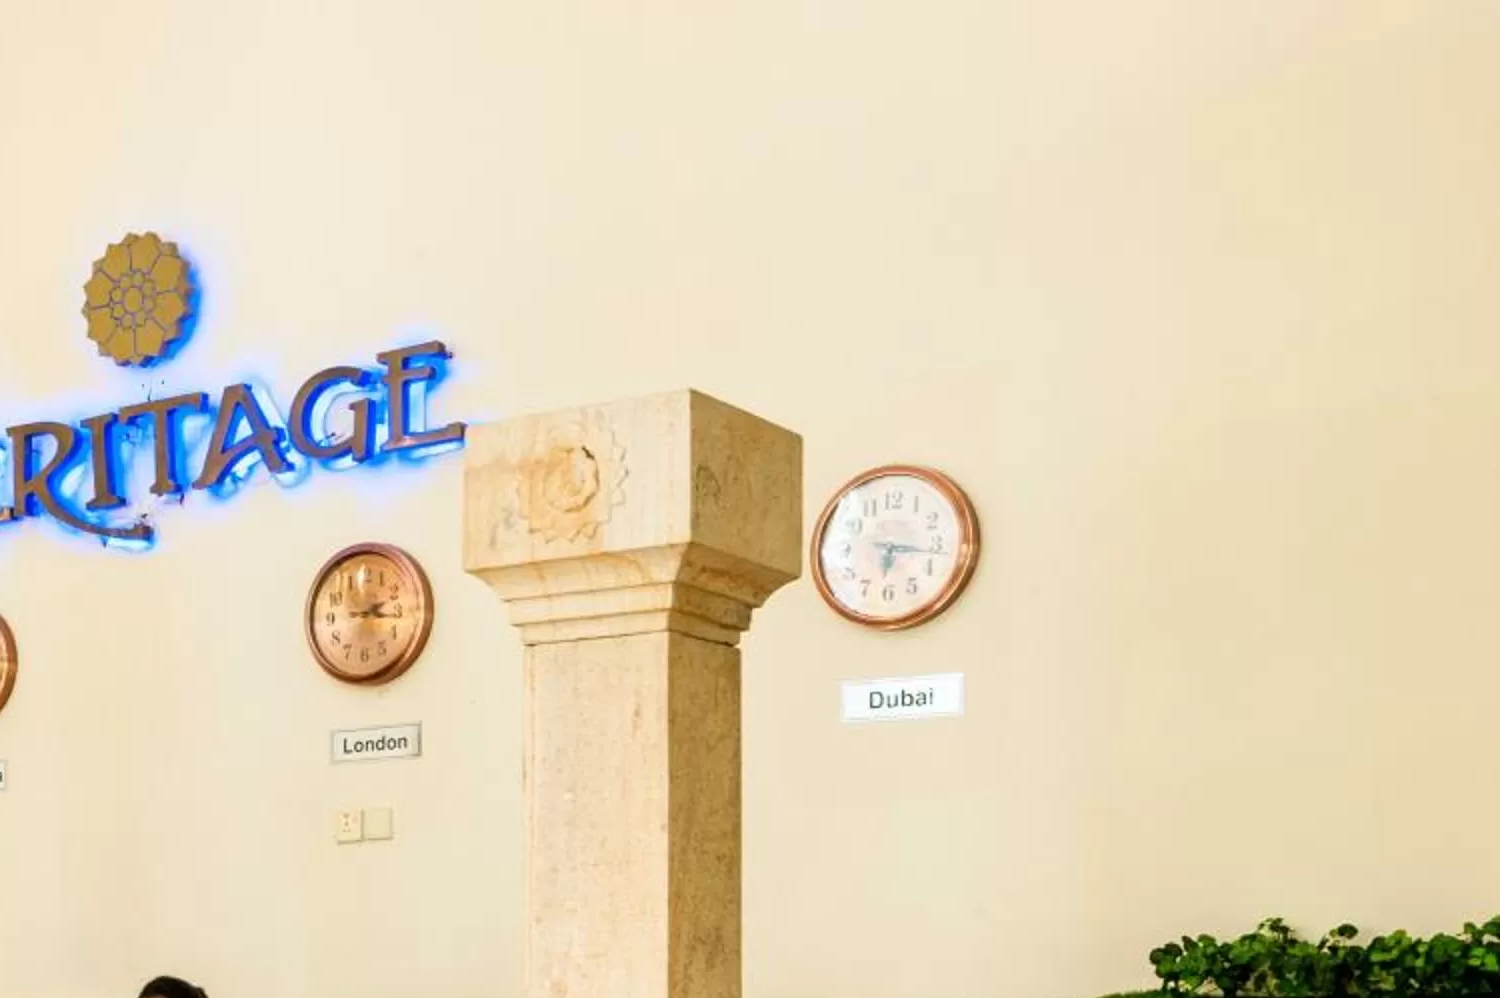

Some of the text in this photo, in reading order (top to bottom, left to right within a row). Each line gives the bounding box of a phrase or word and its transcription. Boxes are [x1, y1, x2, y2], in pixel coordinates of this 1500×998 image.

[863, 499, 877, 517] 11
[884, 491, 904, 510] 12
[913, 495, 919, 513] 1
[925, 511, 939, 530] 2
[931, 534, 943, 554] 3
[379, 570, 385, 587] 1
[905, 577, 918, 595] 5
[389, 583, 399, 600] 2
[859, 579, 872, 597] 7
[882, 583, 896, 601] 6
[329, 591, 343, 608] 10
[325, 611, 335, 626] 9
[342, 643, 353, 660] 7
[360, 647, 369, 662] 6
[377, 640, 387, 656] 5
[868, 687, 935, 710] Dubai
[342, 734, 409, 755] London
